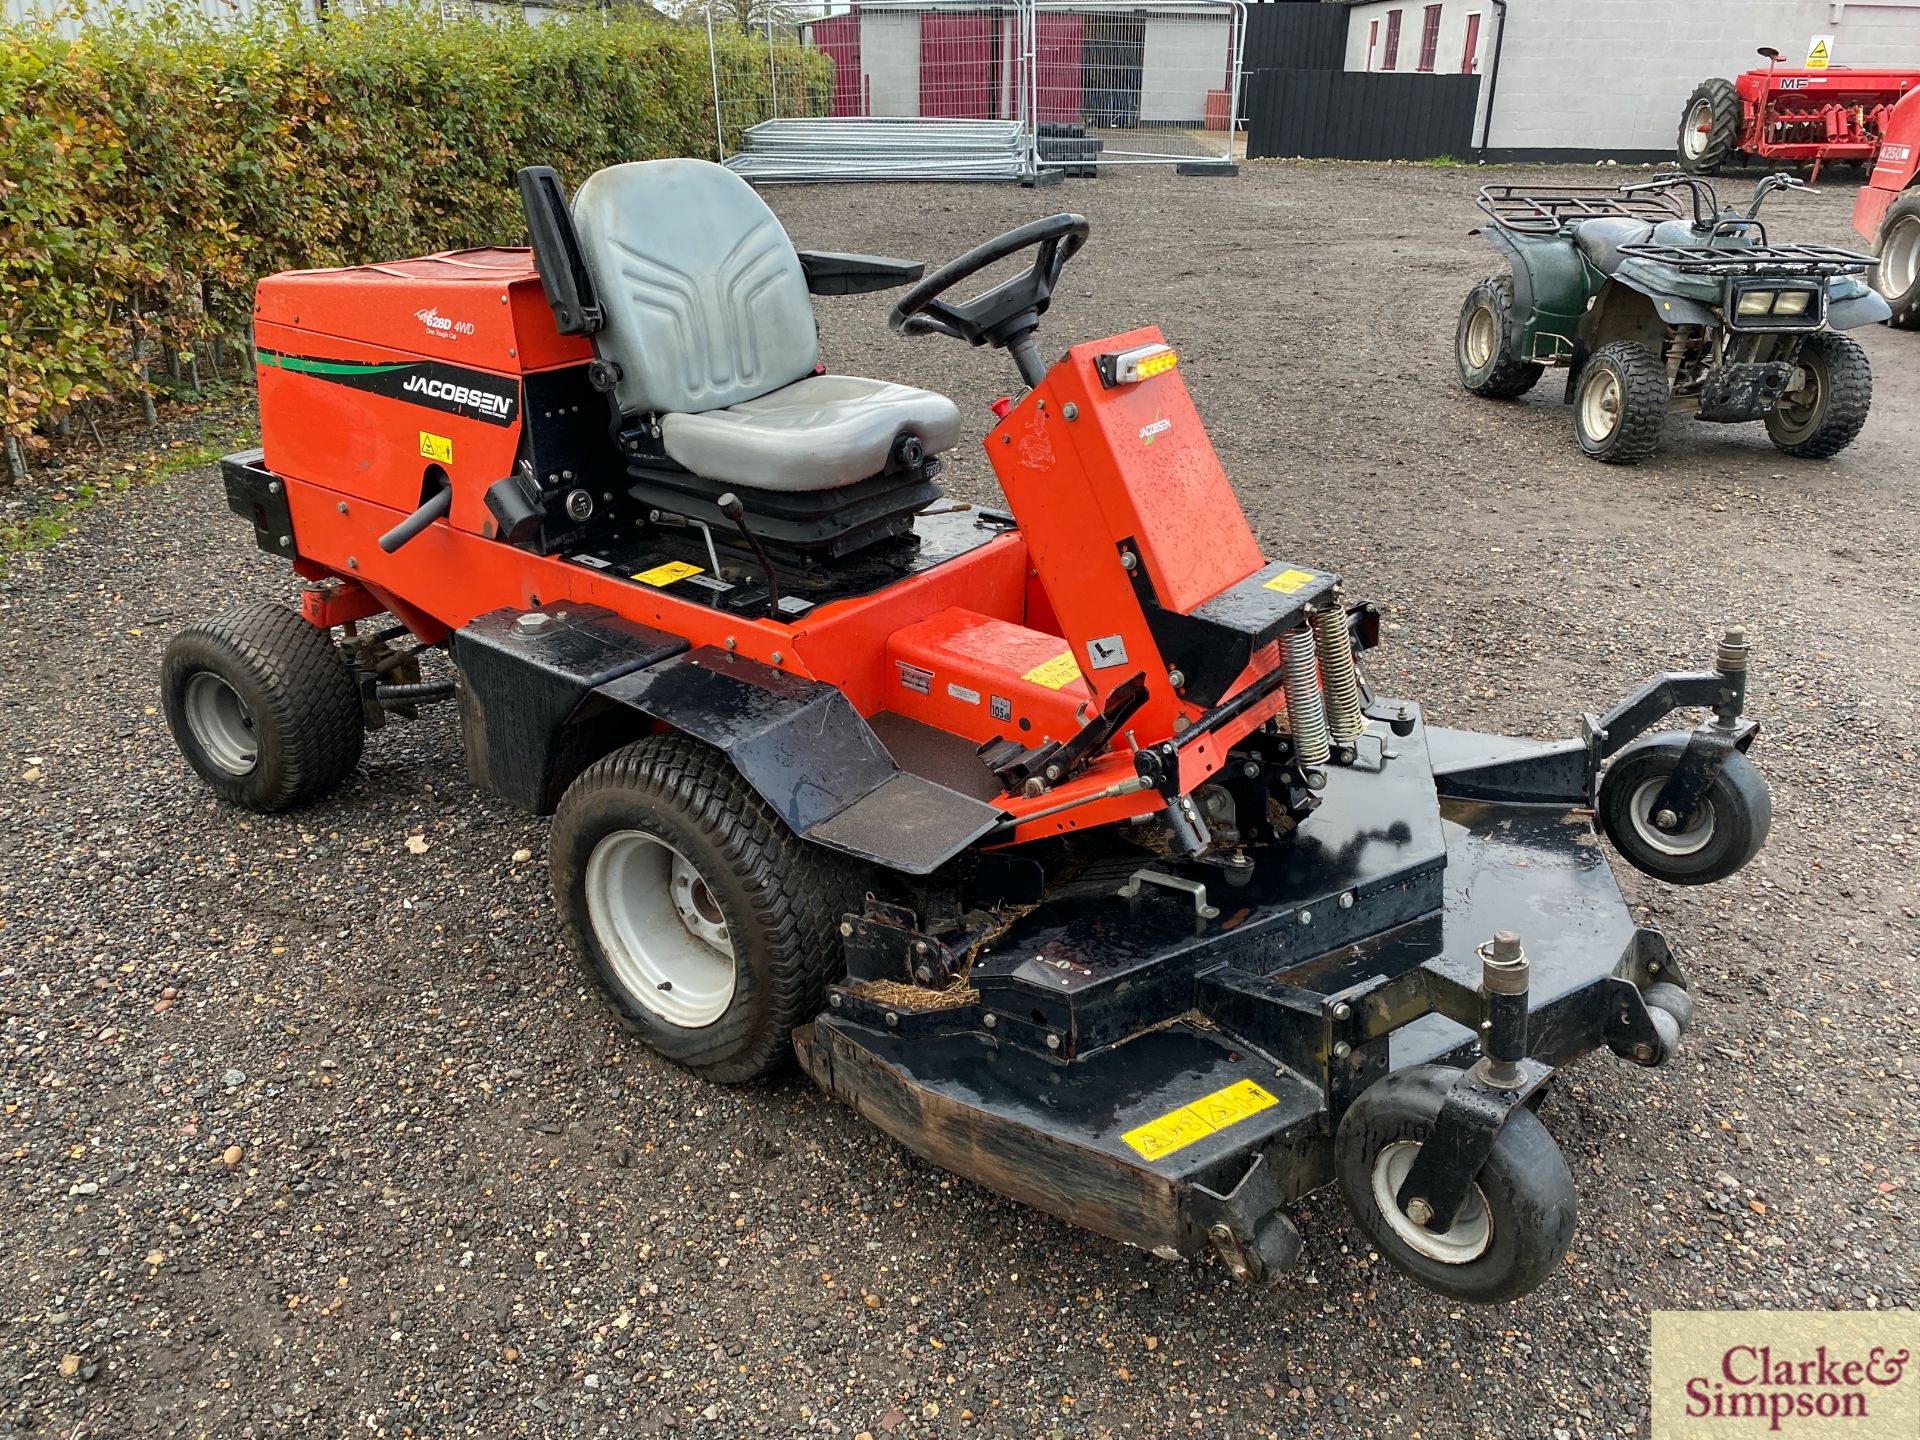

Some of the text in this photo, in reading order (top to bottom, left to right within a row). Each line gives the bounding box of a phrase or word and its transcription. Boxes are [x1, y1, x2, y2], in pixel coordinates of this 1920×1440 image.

[1780, 77, 1809, 90] MF
[1878, 146, 1902, 161] 4250
[426, 315, 452, 330] 628D
[454, 321, 475, 335] 4WD
[403, 375, 512, 415] JACOBSEN
[1138, 417, 1172, 439] JACOBSEN
[992, 705, 1004, 718] 105
